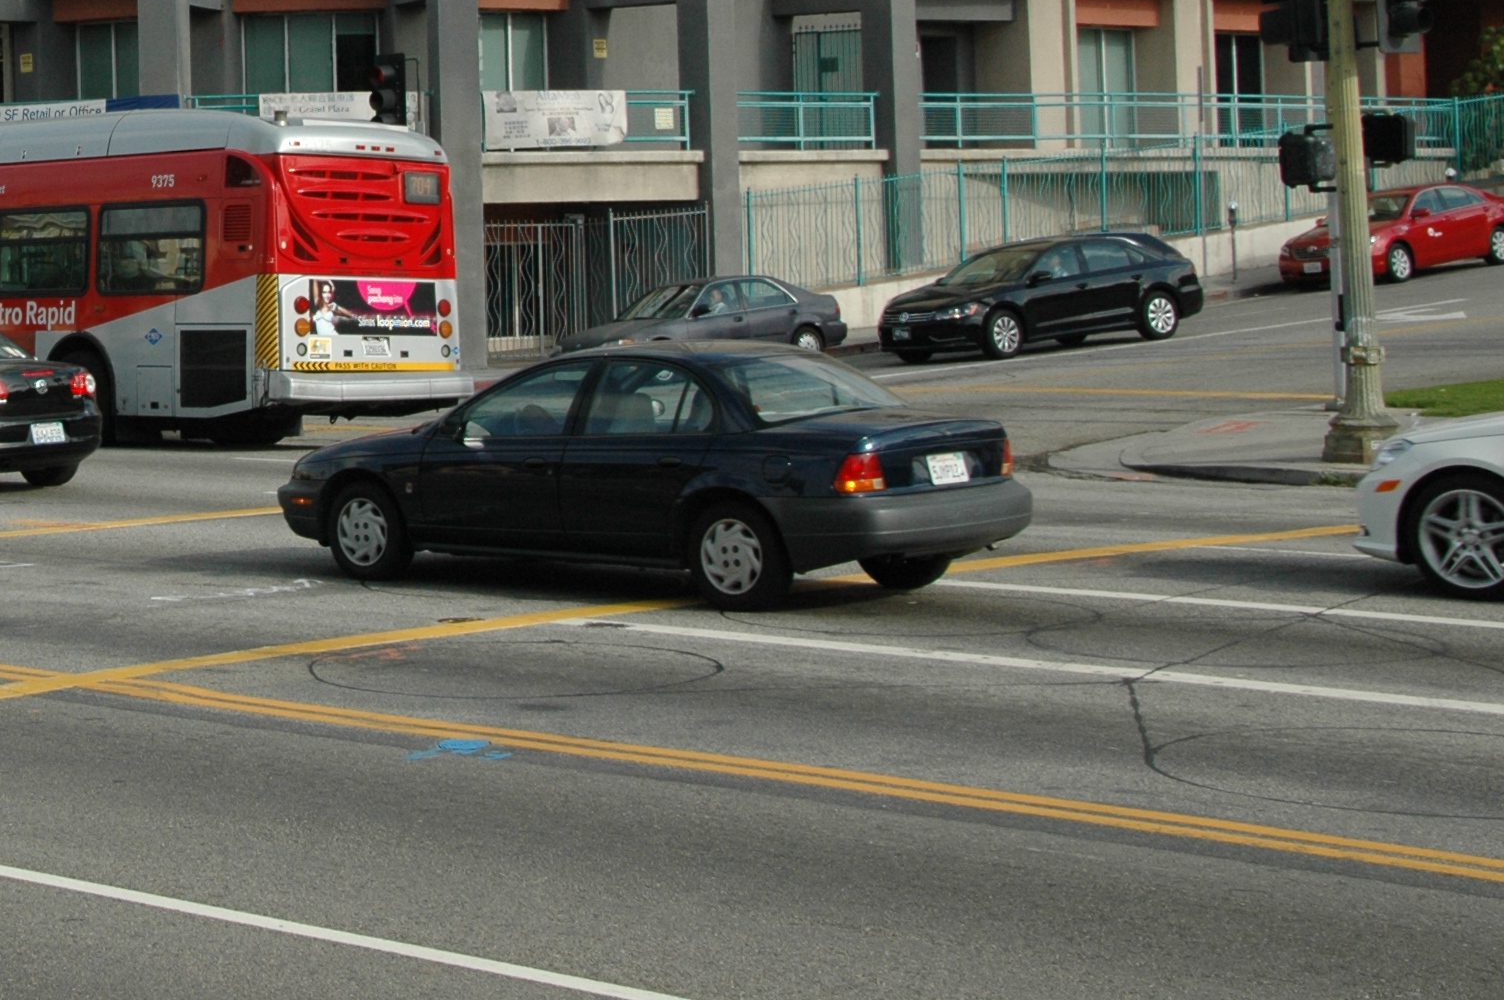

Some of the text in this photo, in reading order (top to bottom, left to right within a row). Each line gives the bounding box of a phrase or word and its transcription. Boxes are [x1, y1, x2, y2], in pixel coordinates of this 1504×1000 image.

[4, 109, 19, 121] SF
[22, 108, 50, 121] Retail
[54, 109, 66, 118] or
[151, 174, 175, 188] 9375
[410, 176, 432, 196] 704
[25, 300, 76, 331] Rapid
